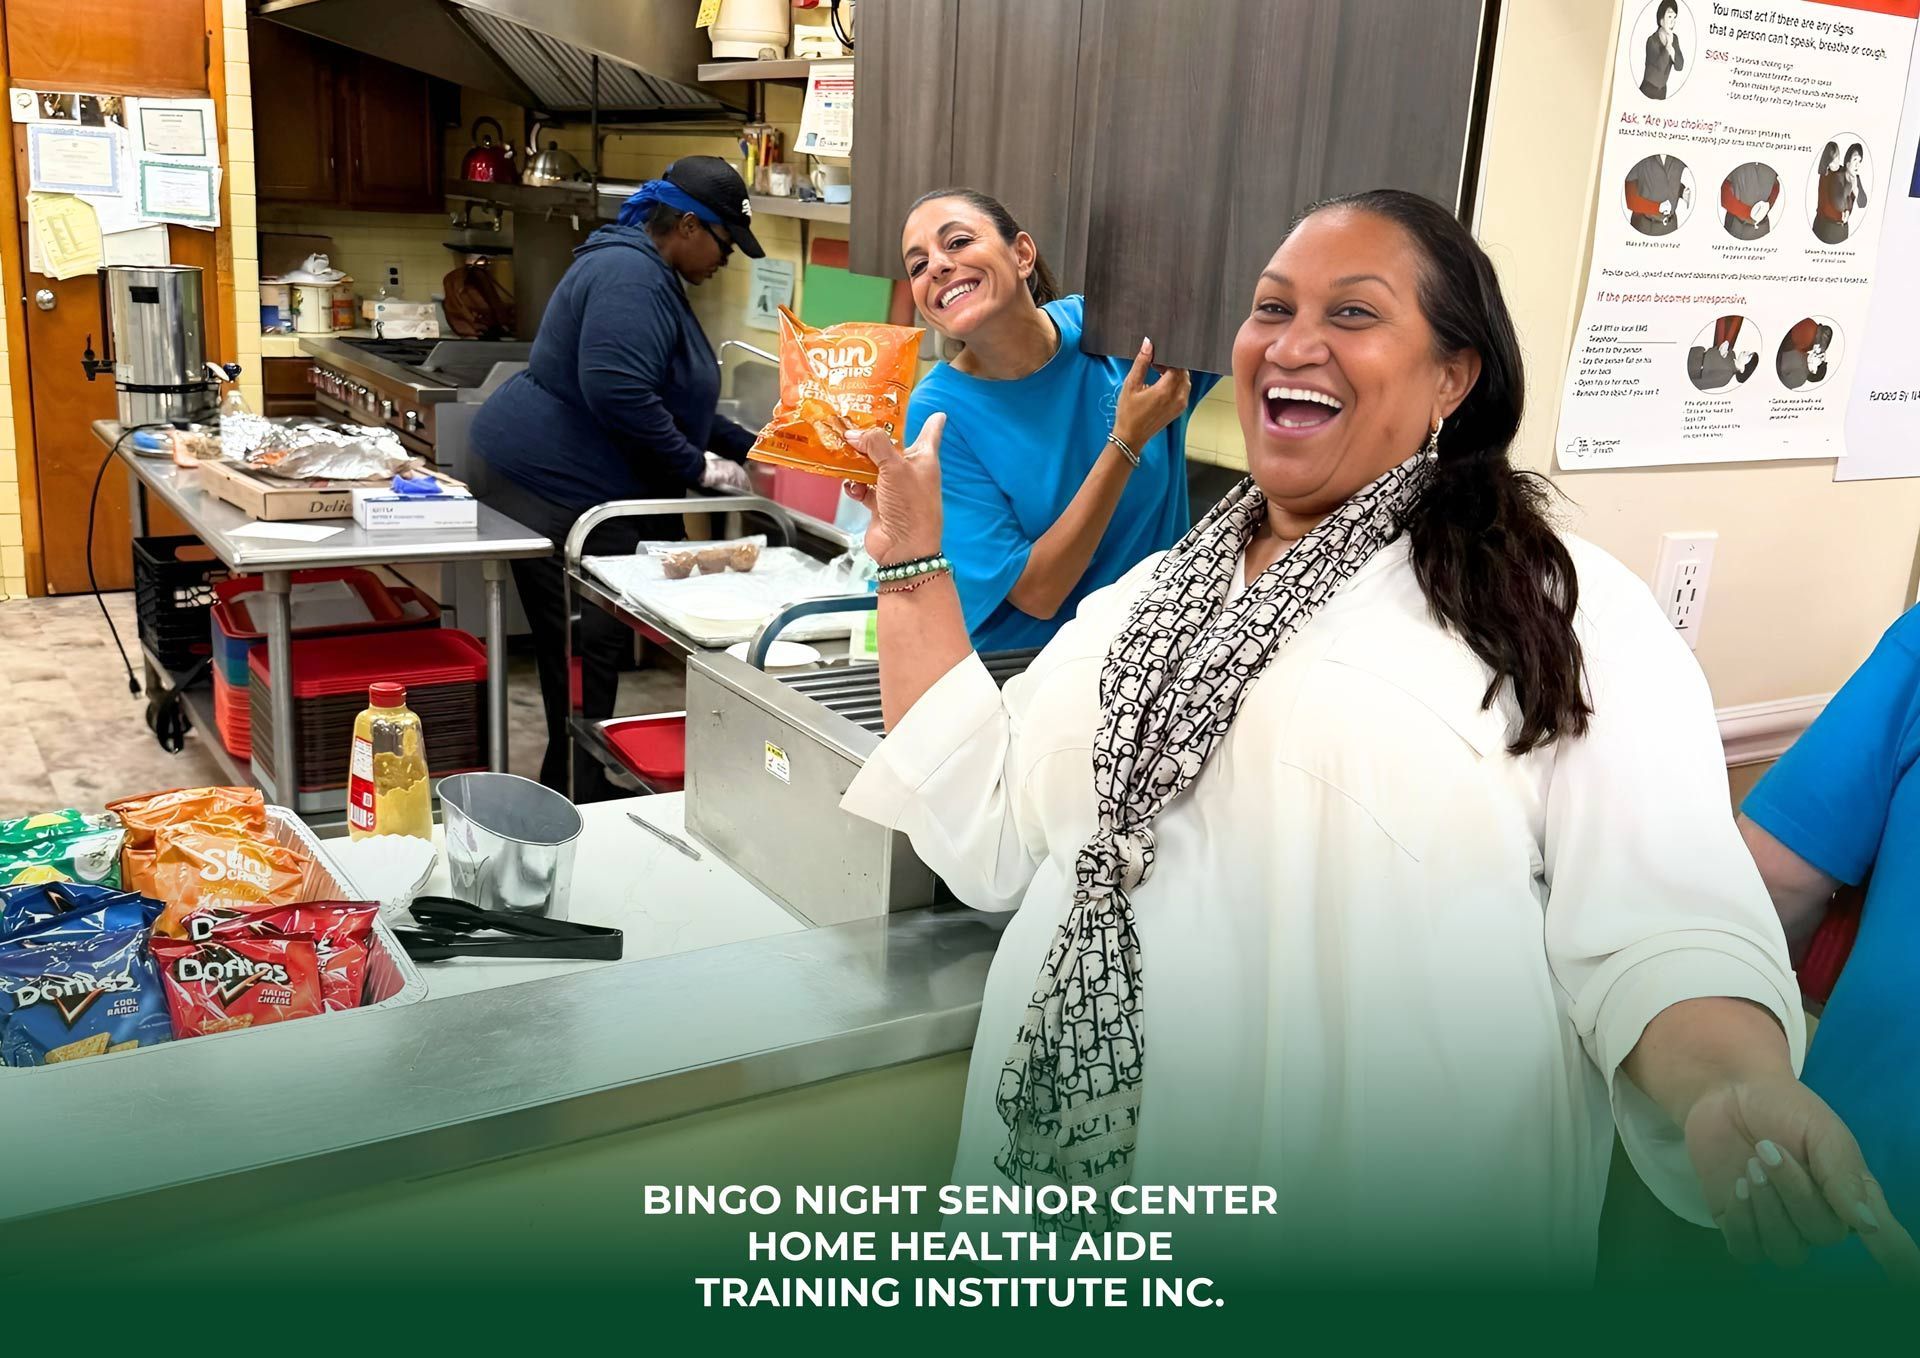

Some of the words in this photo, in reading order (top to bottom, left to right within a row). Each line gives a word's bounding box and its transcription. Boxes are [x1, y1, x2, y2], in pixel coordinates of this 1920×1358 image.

[1713, 2, 1729, 16] You
[1731, 8, 1752, 20] must
[1754, 12, 1768, 22] act
[1769, 11, 1776, 23] if
[1777, 13, 1799, 27] there
[1801, 19, 1814, 29] are
[1817, 21, 1832, 35] any
[1833, 22, 1854, 37] signs
[1709, 23, 1727, 36] that
[1729, 28, 1735, 37] a
[1736, 29, 1766, 41] person
[1819, 38, 1850, 54] breathe
[1663, 118, 1678, 129] you
[1597, 290, 1605, 302] If
[1606, 292, 1620, 303] the
[1622, 293, 1652, 305] person
[1654, 292, 1691, 304] becomes
[200, 848, 272, 882] Sun
[113, 997, 137, 1008] COOL
